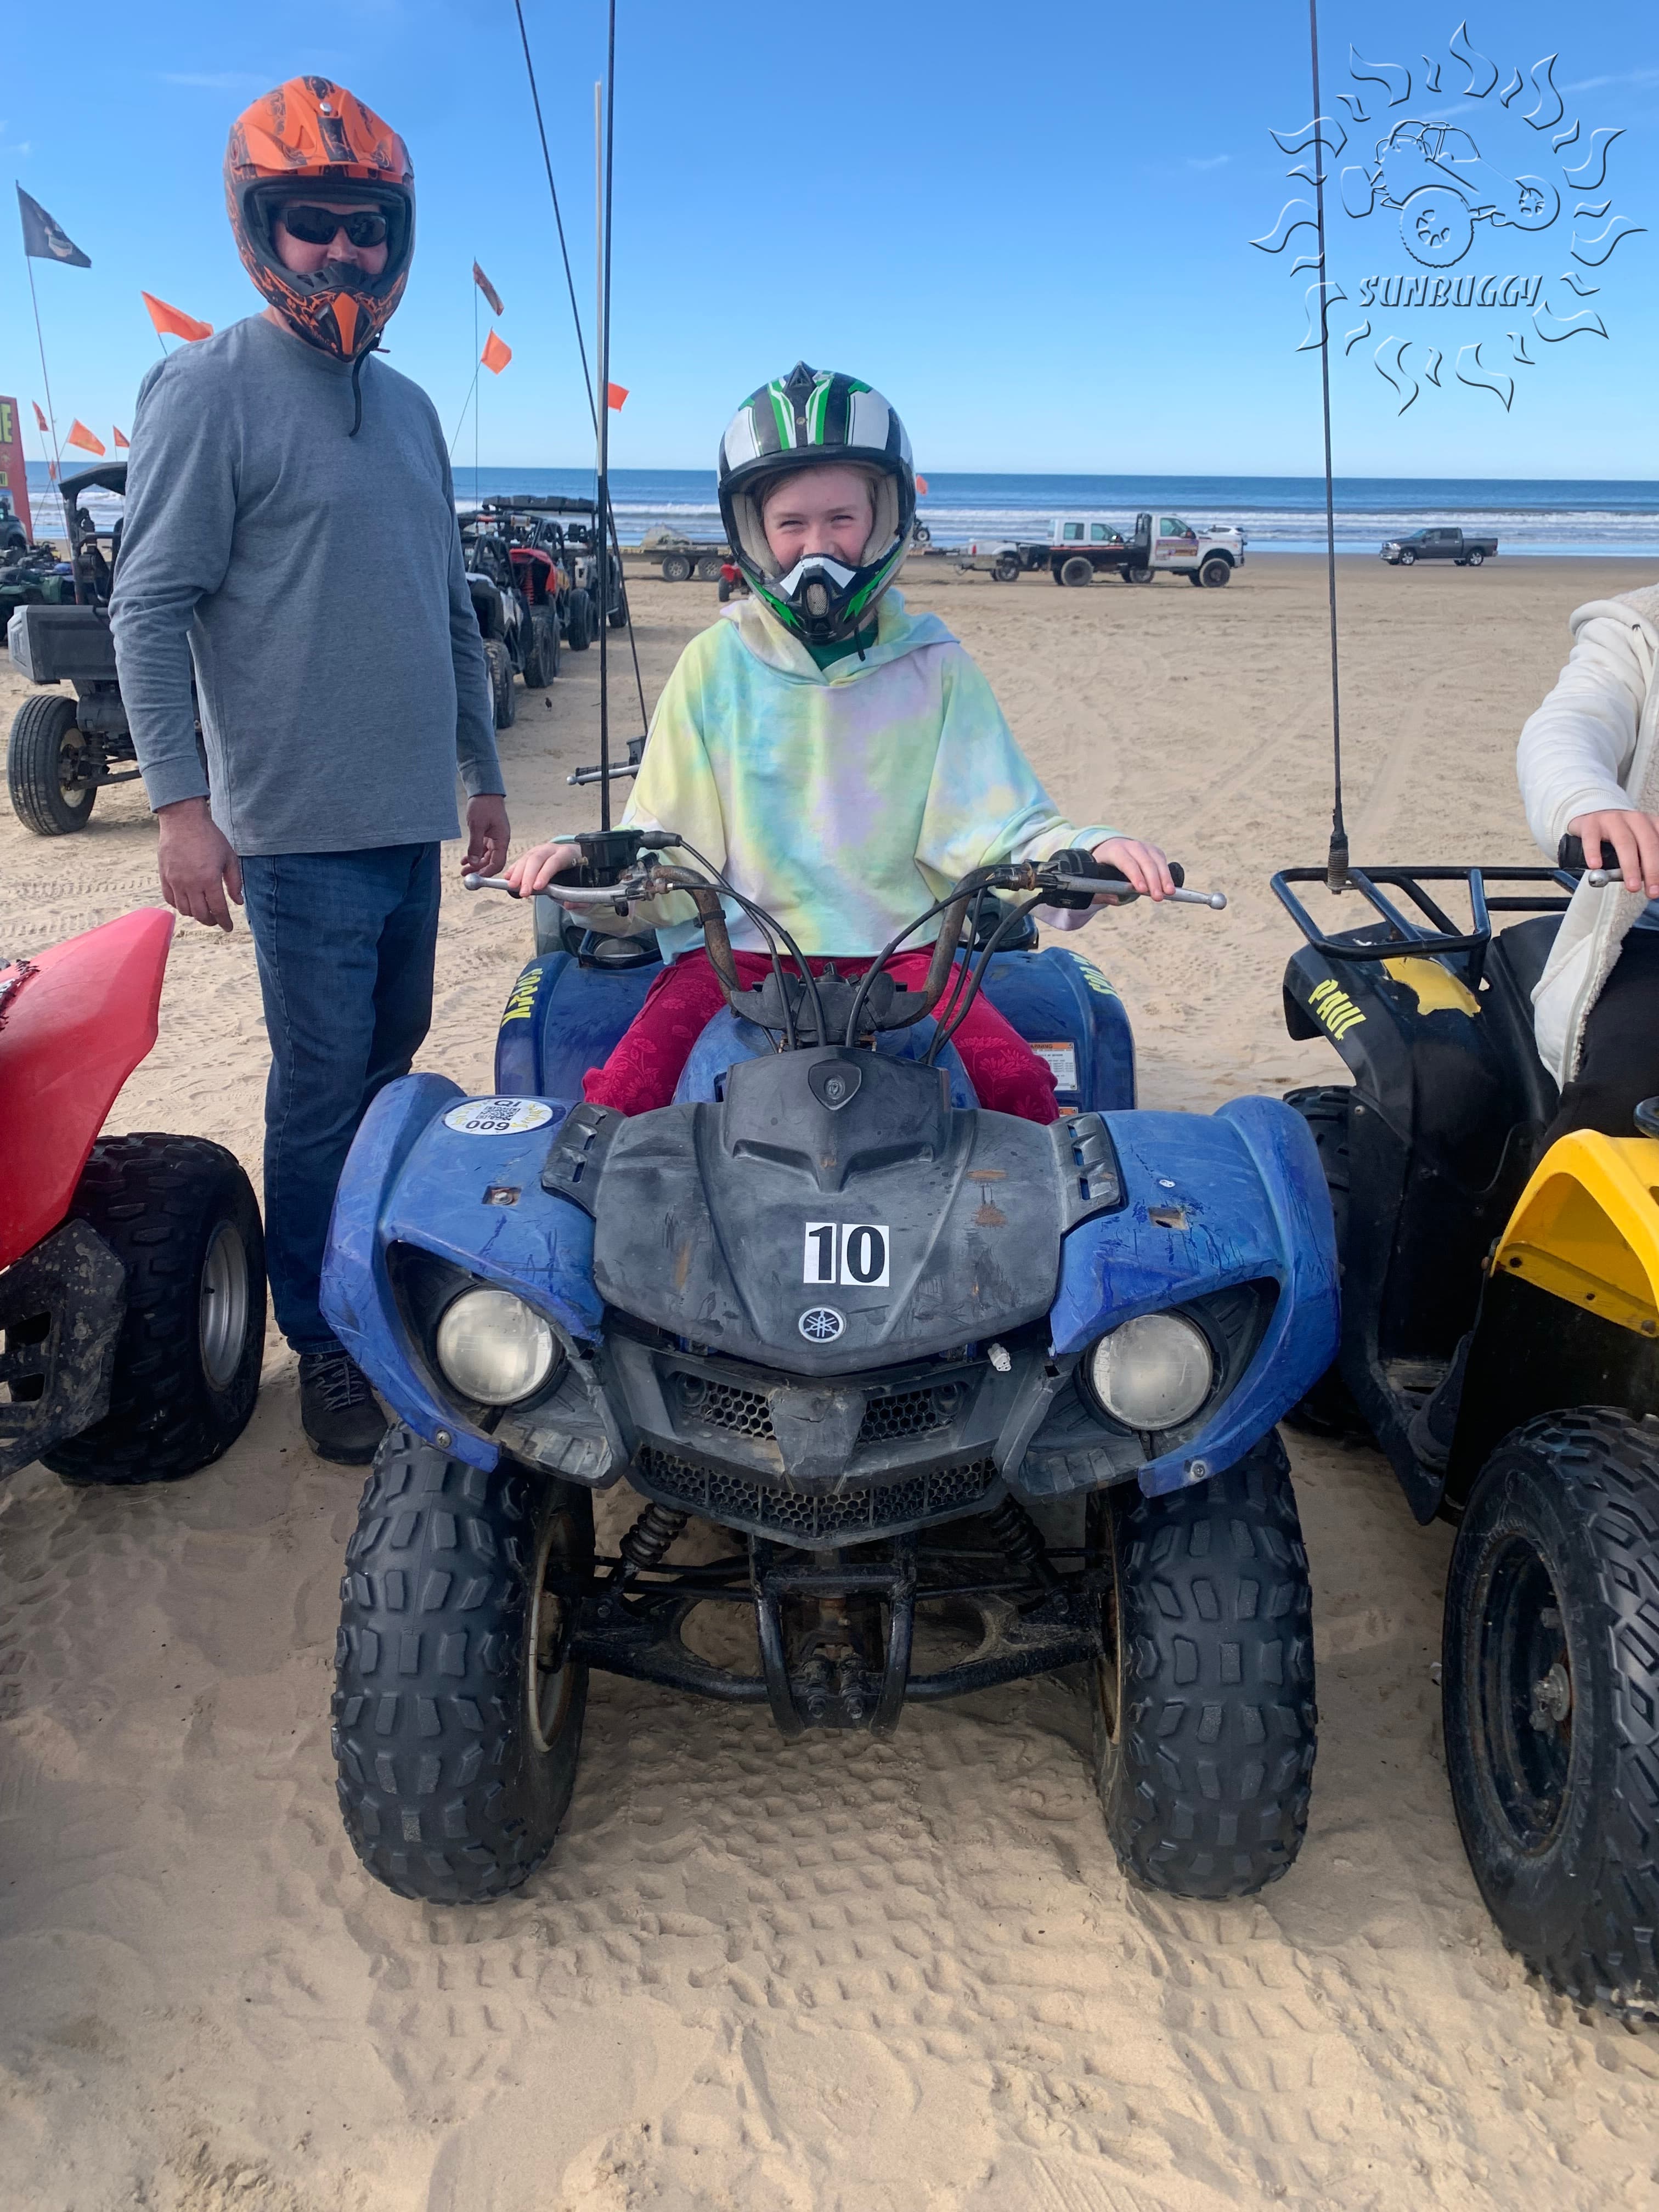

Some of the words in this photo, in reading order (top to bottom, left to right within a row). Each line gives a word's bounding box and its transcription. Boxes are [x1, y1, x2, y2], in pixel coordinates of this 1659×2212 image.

[1308, 979, 1367, 1041] PAUL
[465, 1120, 510, 1131] 009
[809, 1226, 885, 1283] 10
